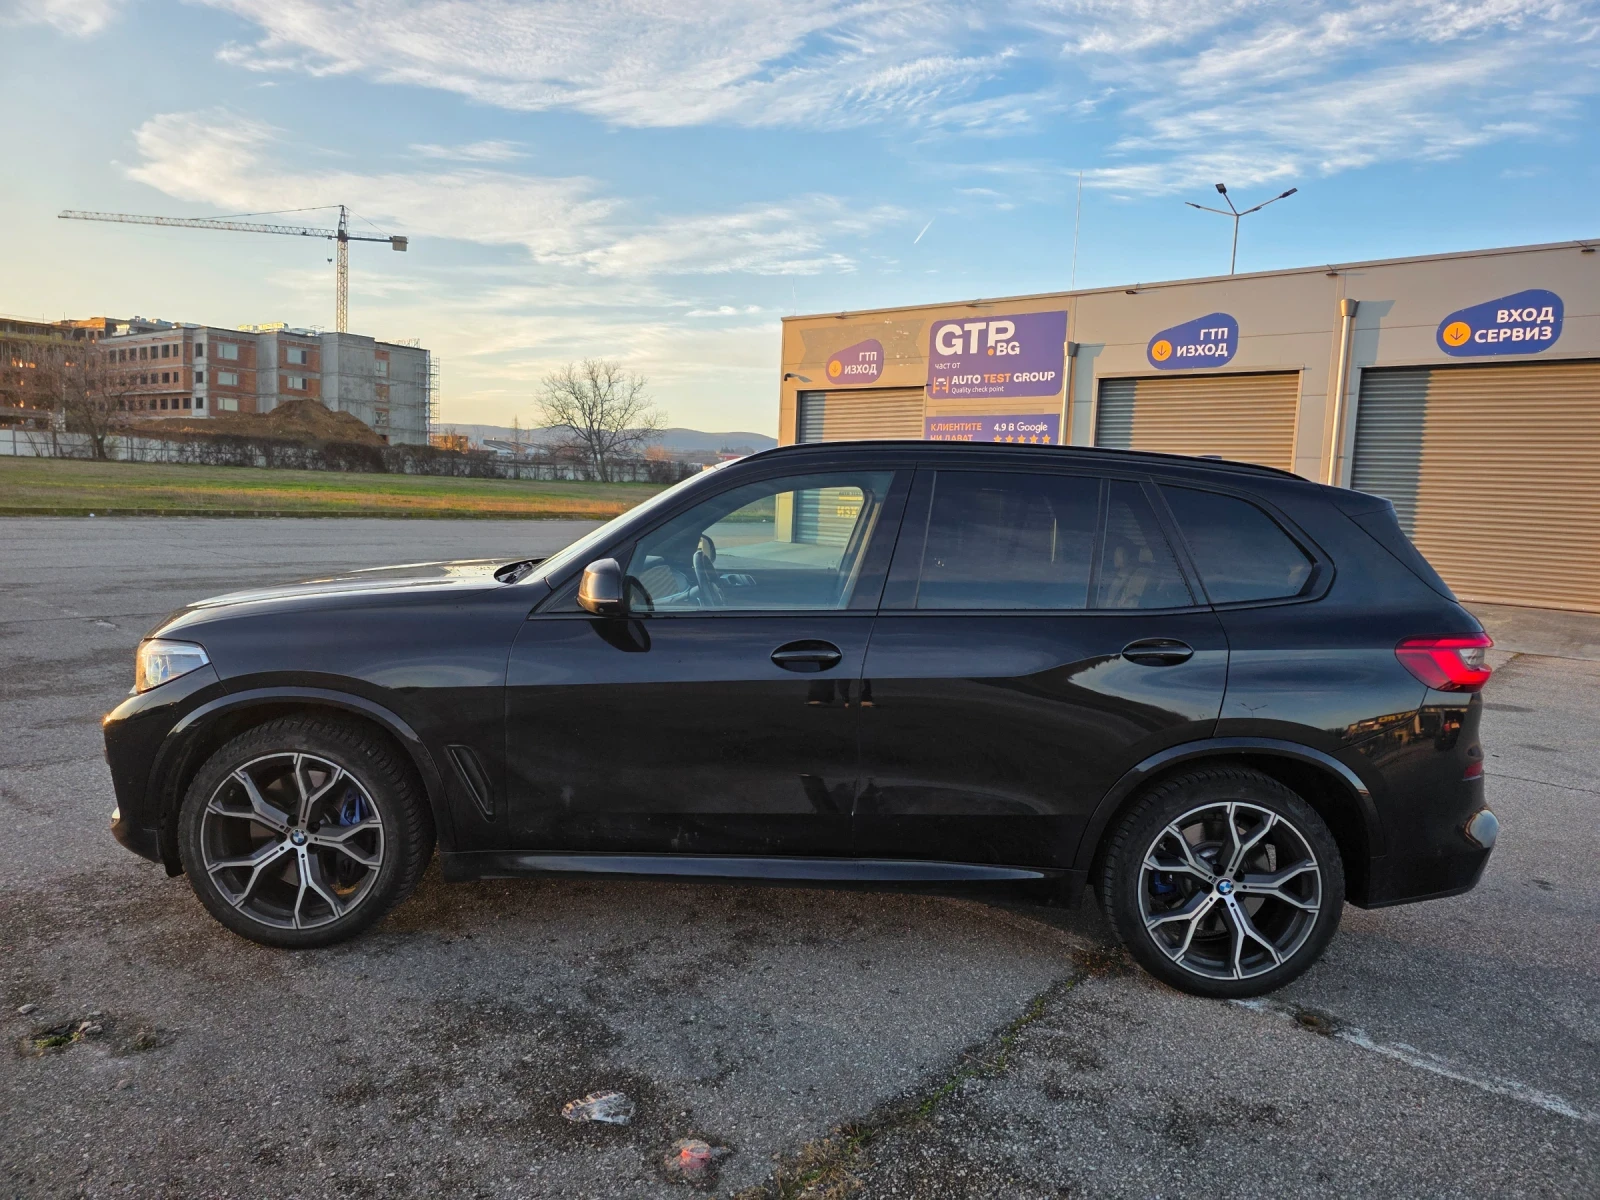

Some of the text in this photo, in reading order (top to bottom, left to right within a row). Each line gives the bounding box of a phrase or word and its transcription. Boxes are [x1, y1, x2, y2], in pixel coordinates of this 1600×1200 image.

[1496, 306, 1554, 324] ВХОД
[1199, 327, 1228, 341] ГТП
[1474, 326, 1552, 343] СЕРВИЗ
[859, 351, 877, 361] ГТП
[1176, 342, 1228, 358] ИЗХОД
[844, 363, 877, 375] ИЗХОД
[934, 362, 950, 370] част
[951, 371, 1056, 385] AUTO TEST GROUP
[951, 386, 971, 394] Quality
[988, 386, 1005, 394] point
[930, 422, 982, 432] КЛИЕНТИТЕ
[993, 423, 1007, 432] 4.9
[1016, 422, 1048, 434] Google
